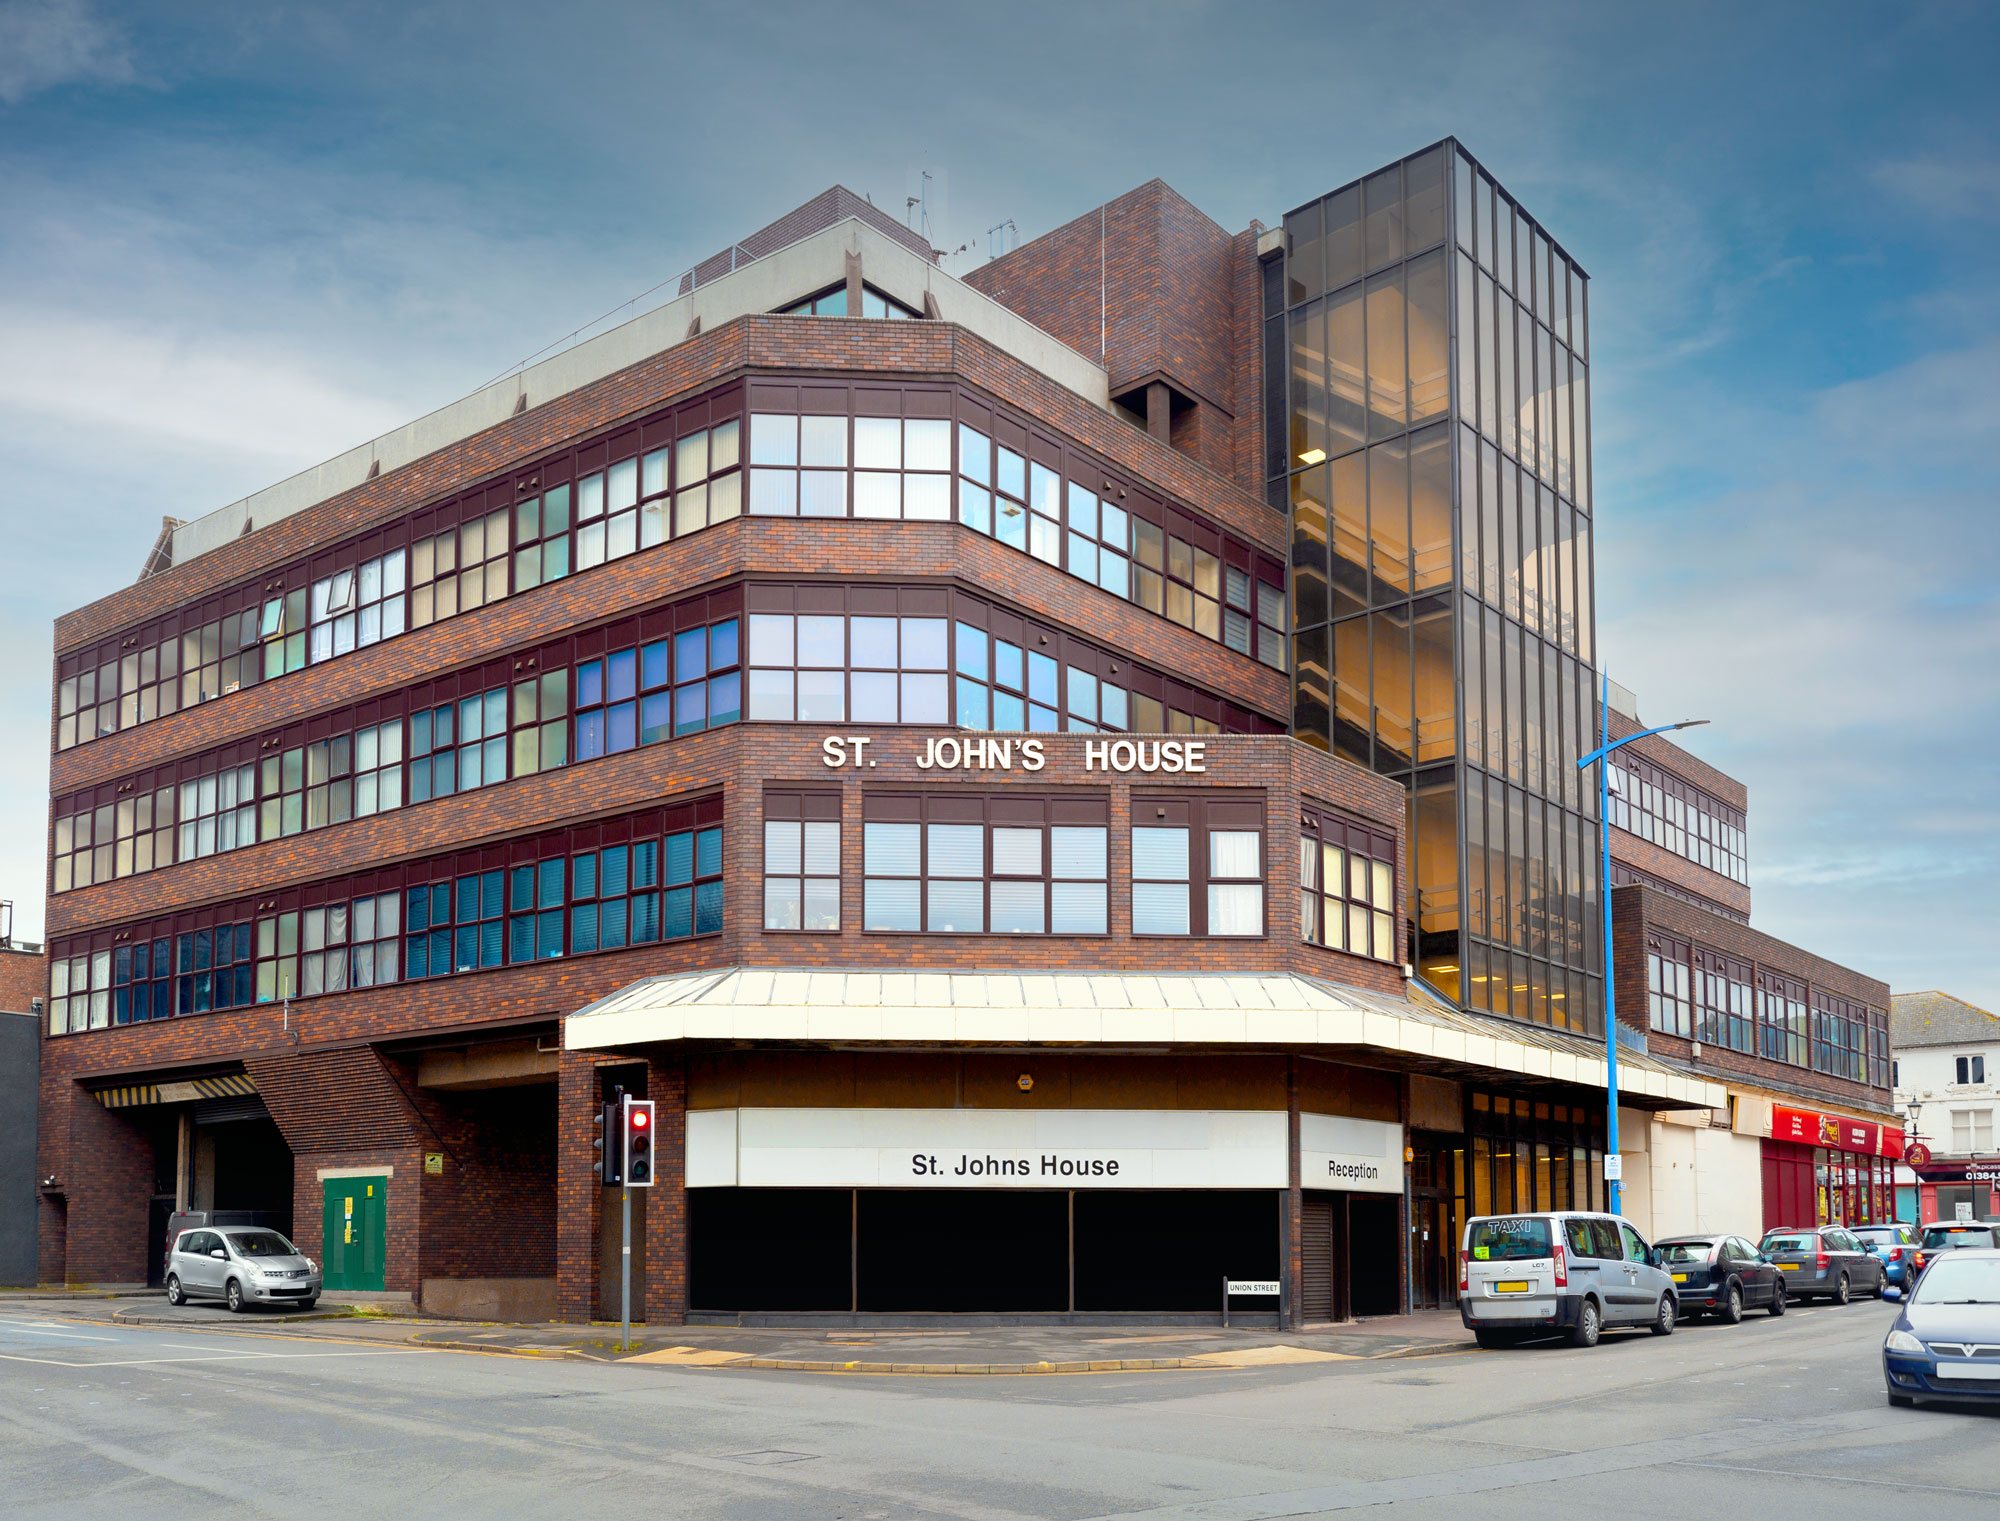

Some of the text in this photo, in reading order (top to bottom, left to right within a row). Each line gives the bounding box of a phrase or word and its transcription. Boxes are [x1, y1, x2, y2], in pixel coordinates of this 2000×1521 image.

[822, 735, 1206, 772] ST. JOHN'S HOUSE
[912, 1154, 1119, 1176] St. Johns House
[1328, 1160, 1378, 1182] Reception
[1488, 1219, 1531, 1234] TAXI
[1230, 1284, 1278, 1292] UNION STREET
